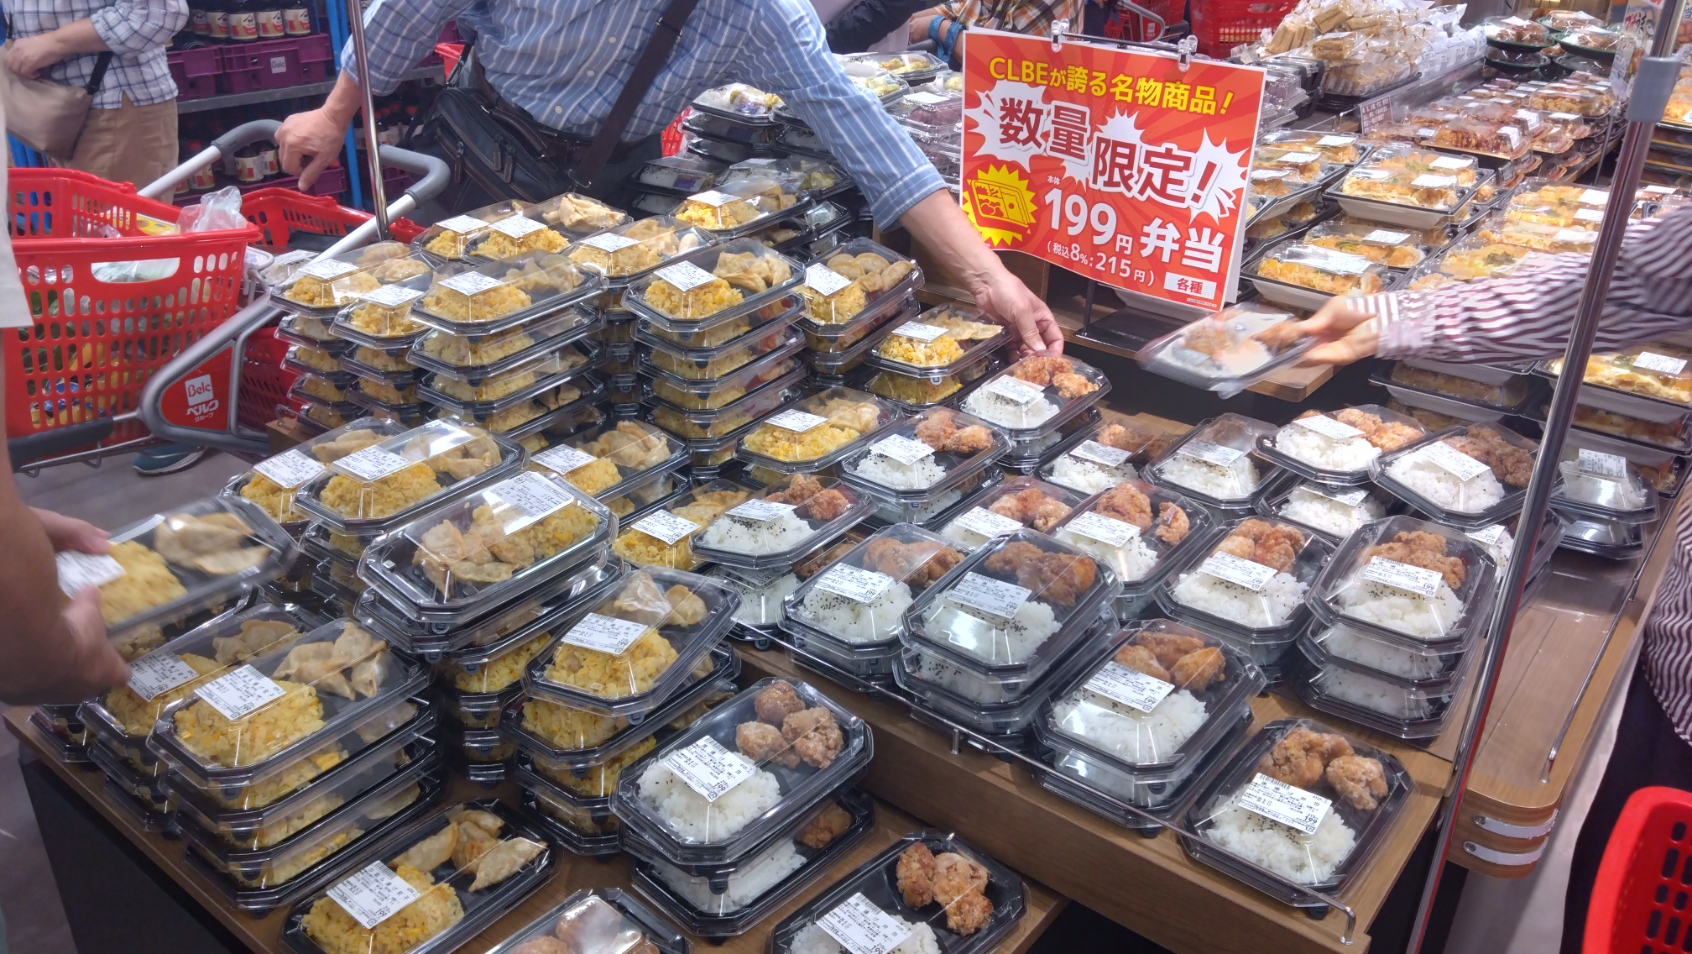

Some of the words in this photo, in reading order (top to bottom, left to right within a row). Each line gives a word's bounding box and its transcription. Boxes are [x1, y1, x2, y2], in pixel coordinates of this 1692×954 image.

[989, 57, 1234, 115] CLBEが誇る名物商品!
[999, 97, 1217, 204] 数量限定!
[1047, 175, 1061, 185] 本体
[1140, 217, 1225, 273] 弁当
[1177, 277, 1204, 295] 各種
[187, 382, 211, 397] Belc
[186, 399, 220, 416] ベルク
[1304, 815, 1318, 824] 199
